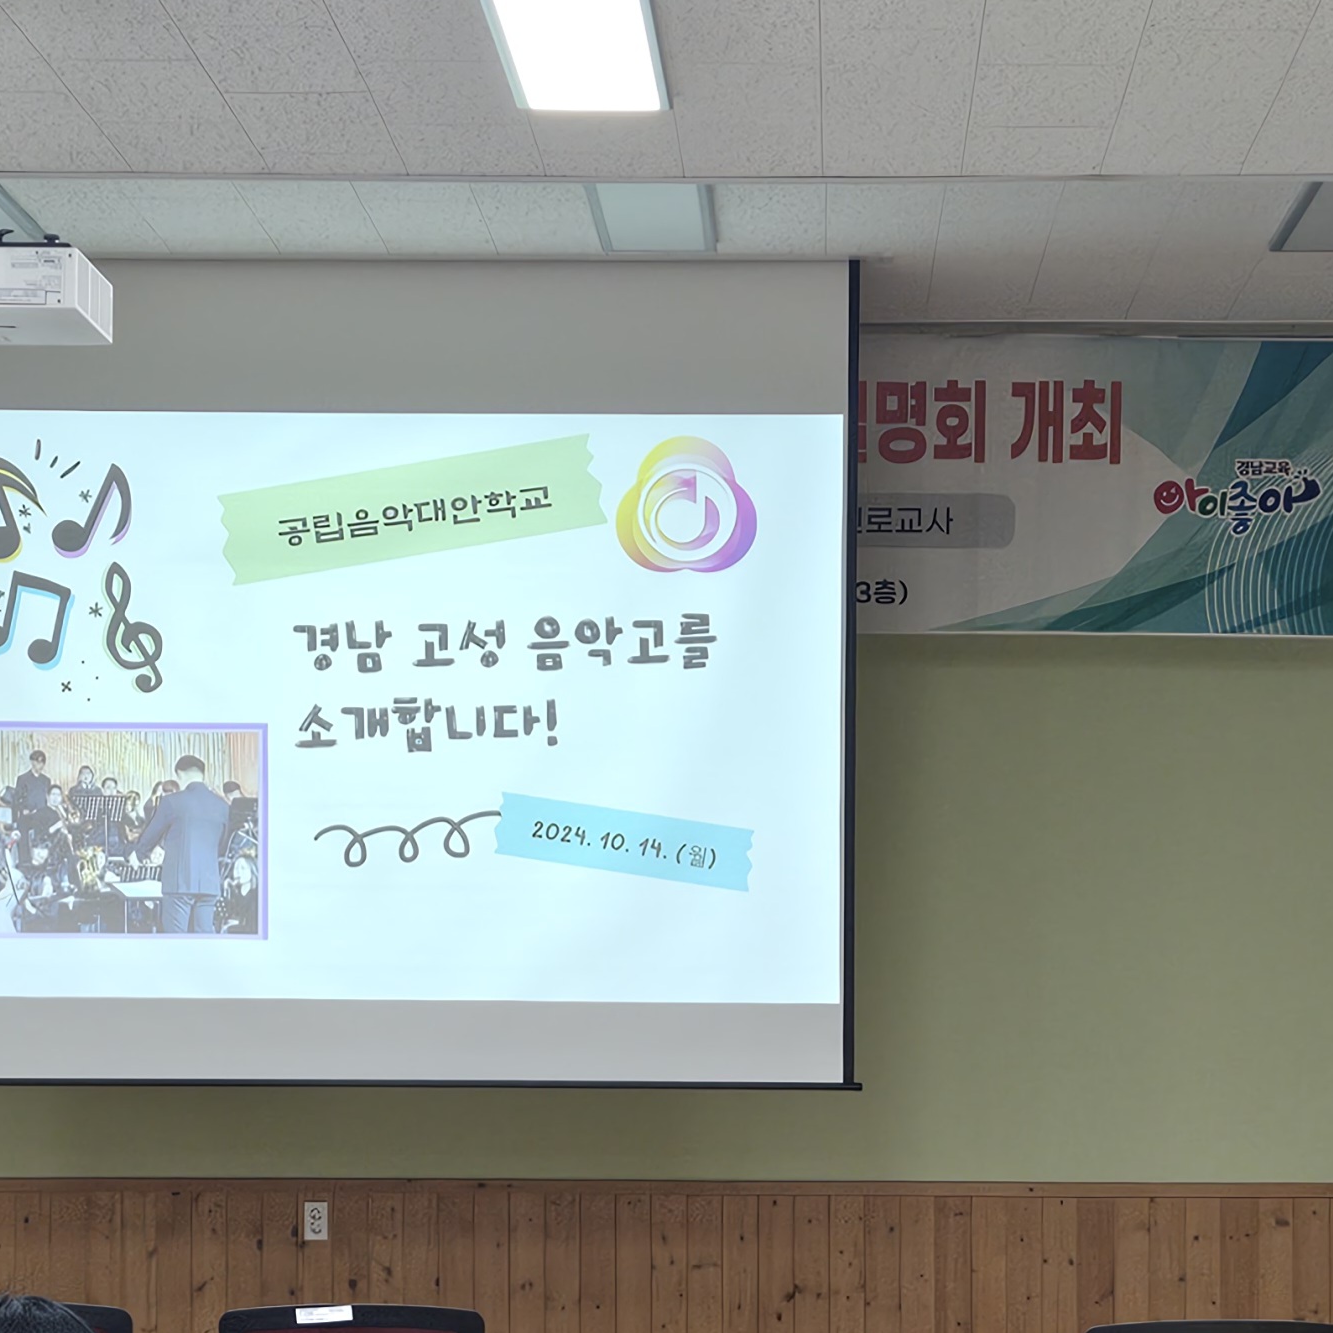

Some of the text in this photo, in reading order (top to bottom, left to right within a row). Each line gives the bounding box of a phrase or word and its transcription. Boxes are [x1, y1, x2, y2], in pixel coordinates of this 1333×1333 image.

[1010, 379, 1122, 464] 개최
[1236, 459, 1292, 476] 경남교육
[277, 484, 553, 547] 공립음악대안학교
[1153, 476, 1322, 535] 아이좋아
[293, 613, 717, 673] 경남 고성 음악고를
[294, 697, 559, 752] 소개합니다!
[532, 820, 717, 870] 2024. 10. 14. (월)
